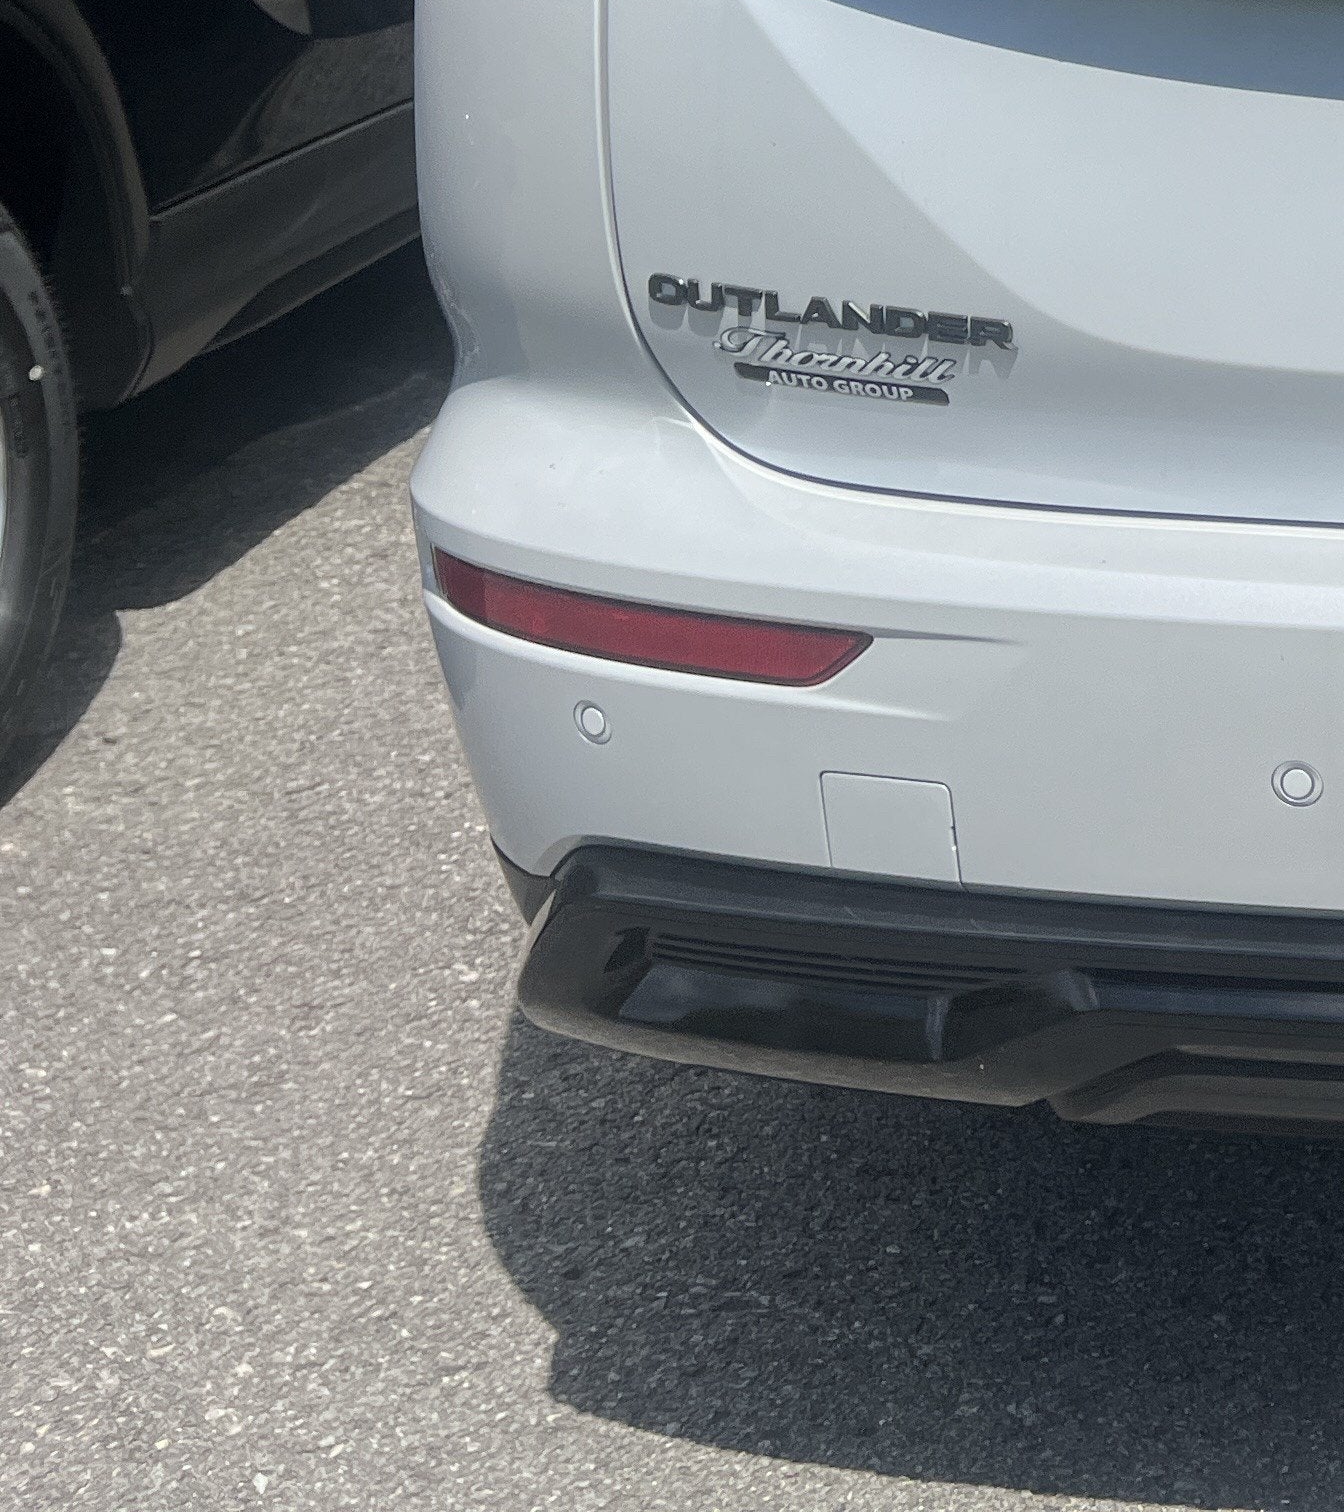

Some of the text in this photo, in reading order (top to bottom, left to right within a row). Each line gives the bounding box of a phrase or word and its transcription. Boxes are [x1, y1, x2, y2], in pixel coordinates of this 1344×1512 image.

[647, 272, 1015, 350] OUTLANDER
[713, 326, 958, 383] Thornhill
[767, 369, 914, 402] AUTO GROUP
